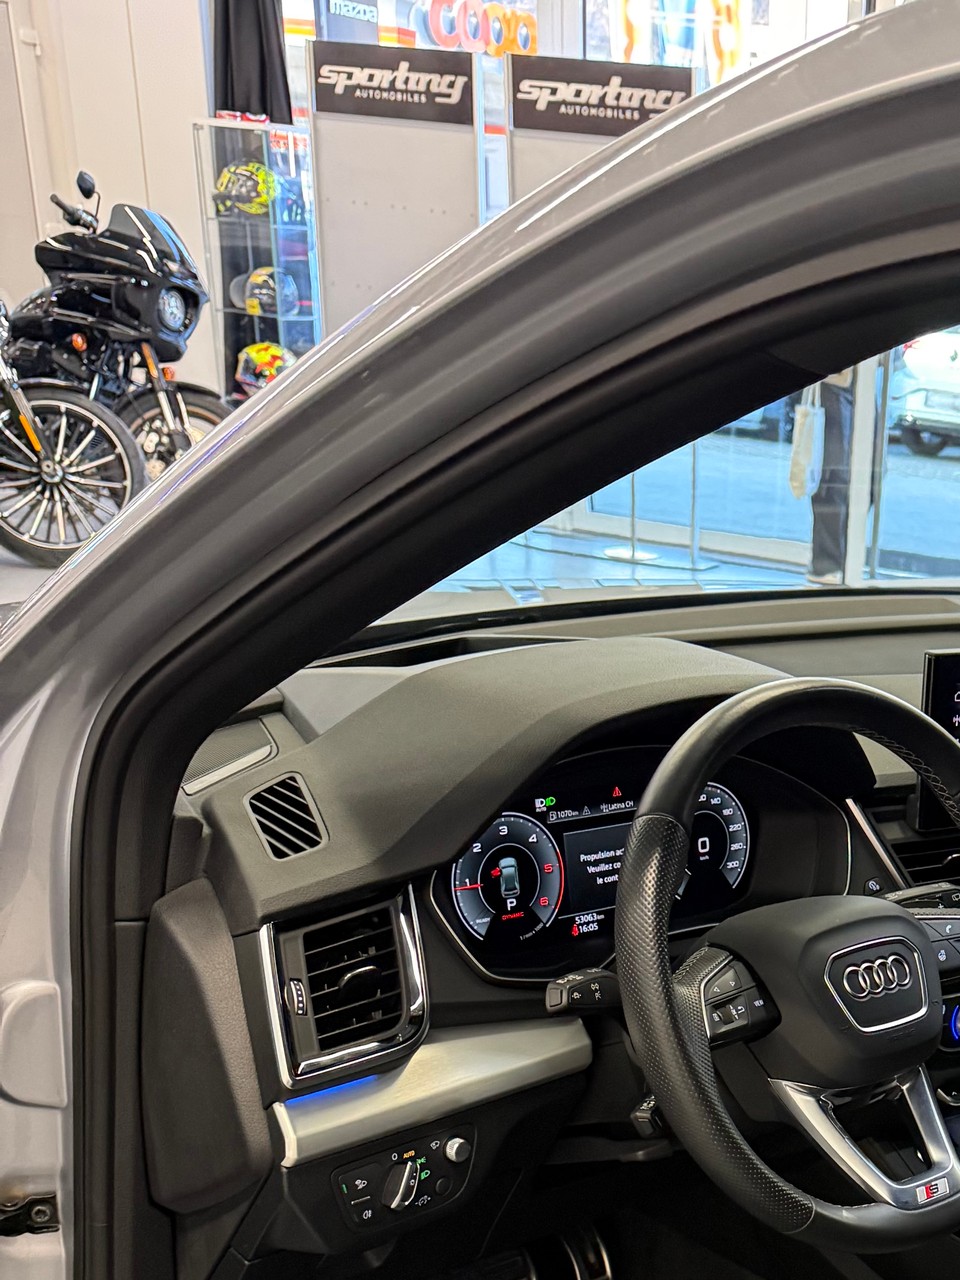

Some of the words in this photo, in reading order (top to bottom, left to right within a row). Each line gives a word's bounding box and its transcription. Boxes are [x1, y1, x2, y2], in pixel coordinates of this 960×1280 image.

[330, 0, 378, 23] mazda
[354, 88, 427, 104] AUTOMOBILES
[558, 103, 640, 121] AUTOMOBILES
[608, 802, 625, 811] Latina
[625, 800, 634, 808] CH
[499, 825, 508, 836] 3
[728, 823, 742, 832] 220
[528, 834, 537, 843] 4
[472, 842, 482, 853] 2
[579, 851, 615, 862] Propulsion
[543, 863, 553, 873] 5
[586, 864, 613, 874] Veuillez
[596, 876, 604, 885] le
[506, 898, 517, 911] P
[539, 896, 549, 906] 6
[578, 922, 599, 934] 16:05
[403, 1149, 416, 1159] AUTO
